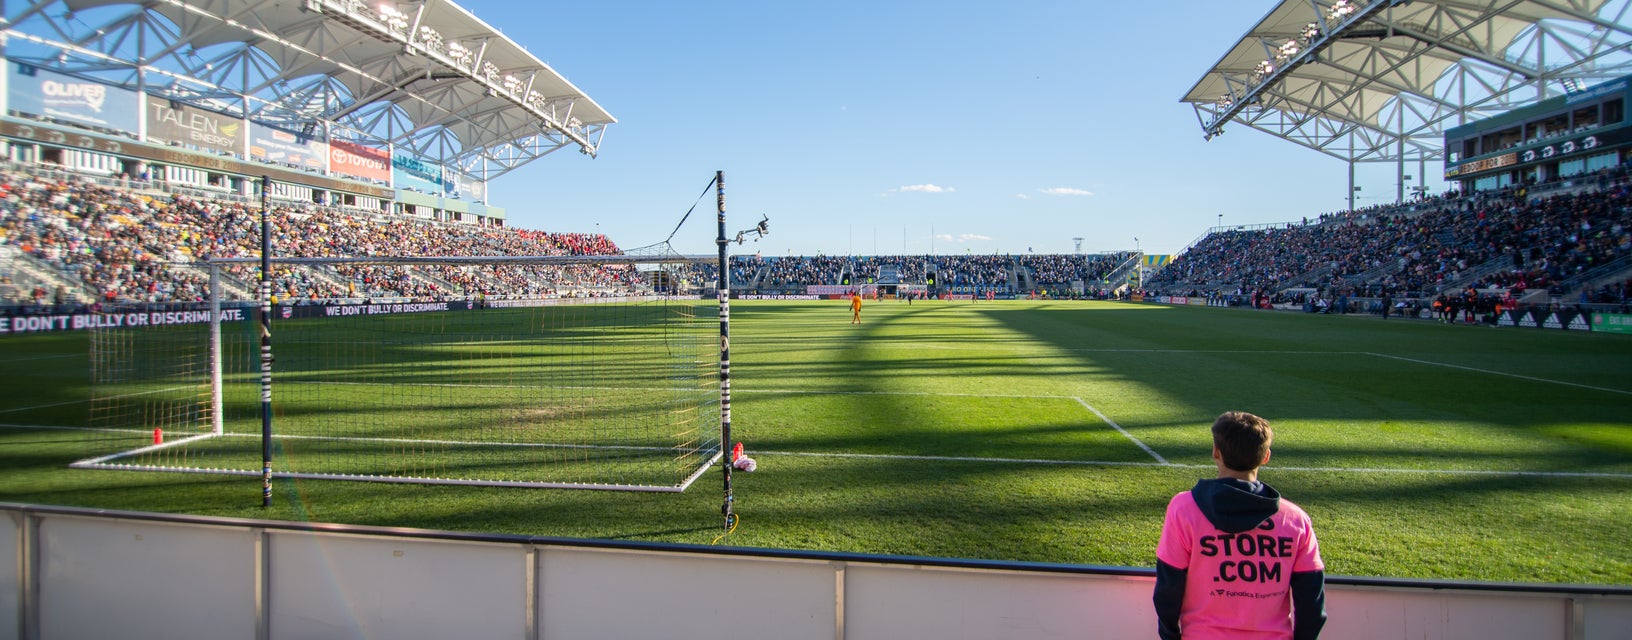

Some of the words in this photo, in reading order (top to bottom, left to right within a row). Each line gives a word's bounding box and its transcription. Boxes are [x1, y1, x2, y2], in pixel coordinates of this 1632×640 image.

[42, 80, 105, 98] OLIVER
[151, 102, 218, 134] TALEN
[191, 130, 235, 147] ENERGY
[348, 153, 387, 171] TOYOTA
[326, 306, 340, 316] WE
[342, 305, 367, 315] DON'T
[368, 304, 392, 314] BULLY
[393, 304, 402, 312] OR
[404, 302, 450, 312] DISCRIMINATE.
[14, 315, 70, 331] DON'T
[73, 314, 124, 328] BULLY
[126, 313, 148, 326] OR
[152, 309, 245, 325] DISCRIMIATE.
[1200, 534, 1293, 557] STORE
[1213, 560, 1281, 583] .COM
[1226, 590, 1254, 598] Fanatics
